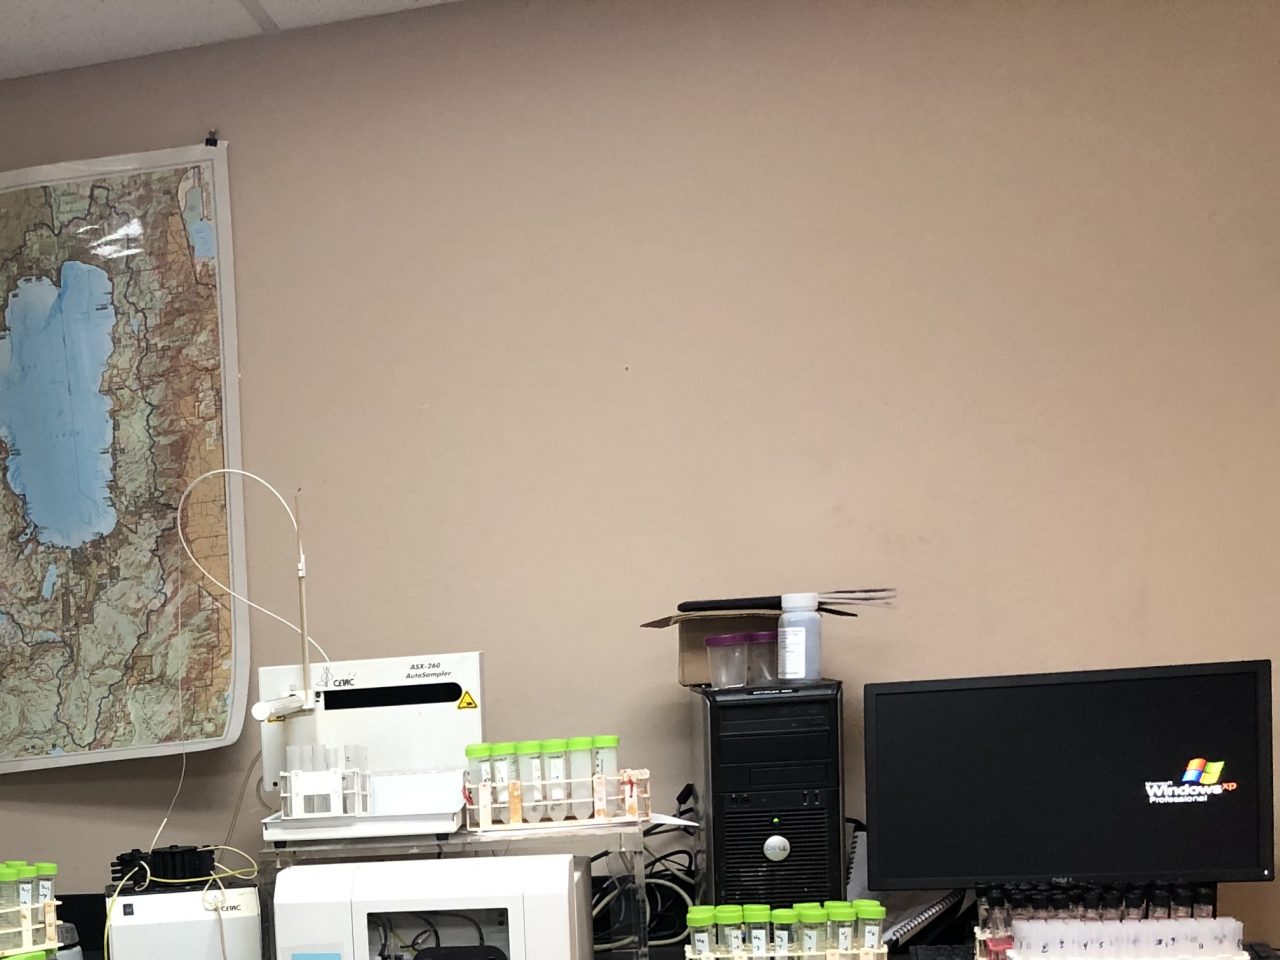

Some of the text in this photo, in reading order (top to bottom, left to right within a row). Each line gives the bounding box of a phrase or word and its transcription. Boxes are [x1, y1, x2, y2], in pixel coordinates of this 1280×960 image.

[405, 670, 452, 679] AutoSampler
[1146, 782, 1238, 797] Windows xp
[1149, 794, 1208, 804] Professional
